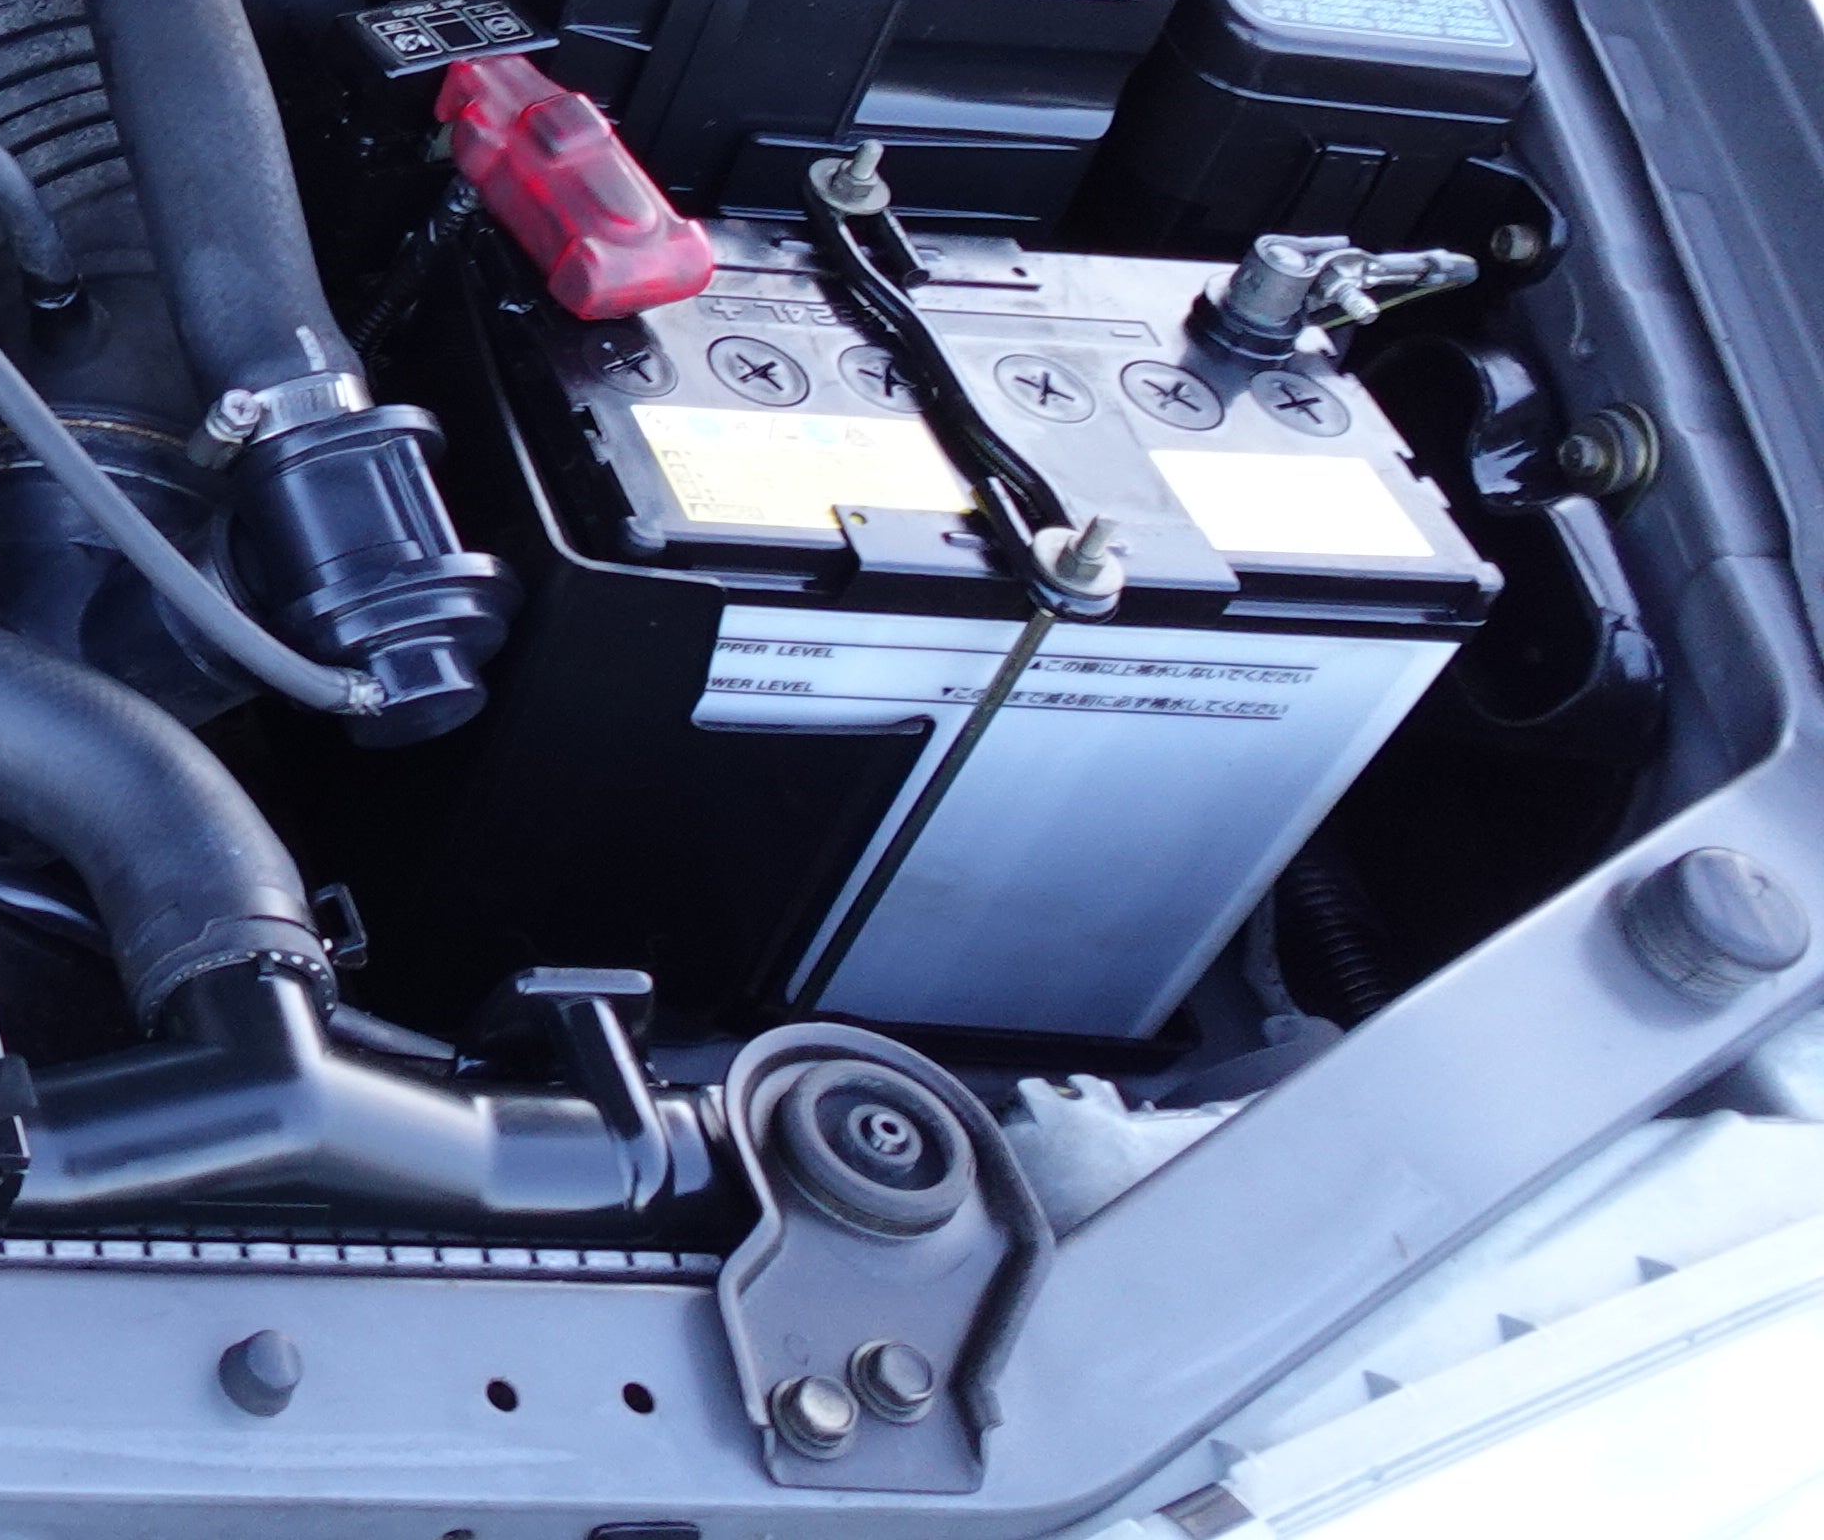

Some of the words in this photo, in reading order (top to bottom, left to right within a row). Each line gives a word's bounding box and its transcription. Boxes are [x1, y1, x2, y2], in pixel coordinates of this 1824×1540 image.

[716, 641, 770, 656] PPER
[775, 644, 837, 659] LEVEL
[710, 676, 754, 690] WER
[755, 678, 816, 693] LEVEL
